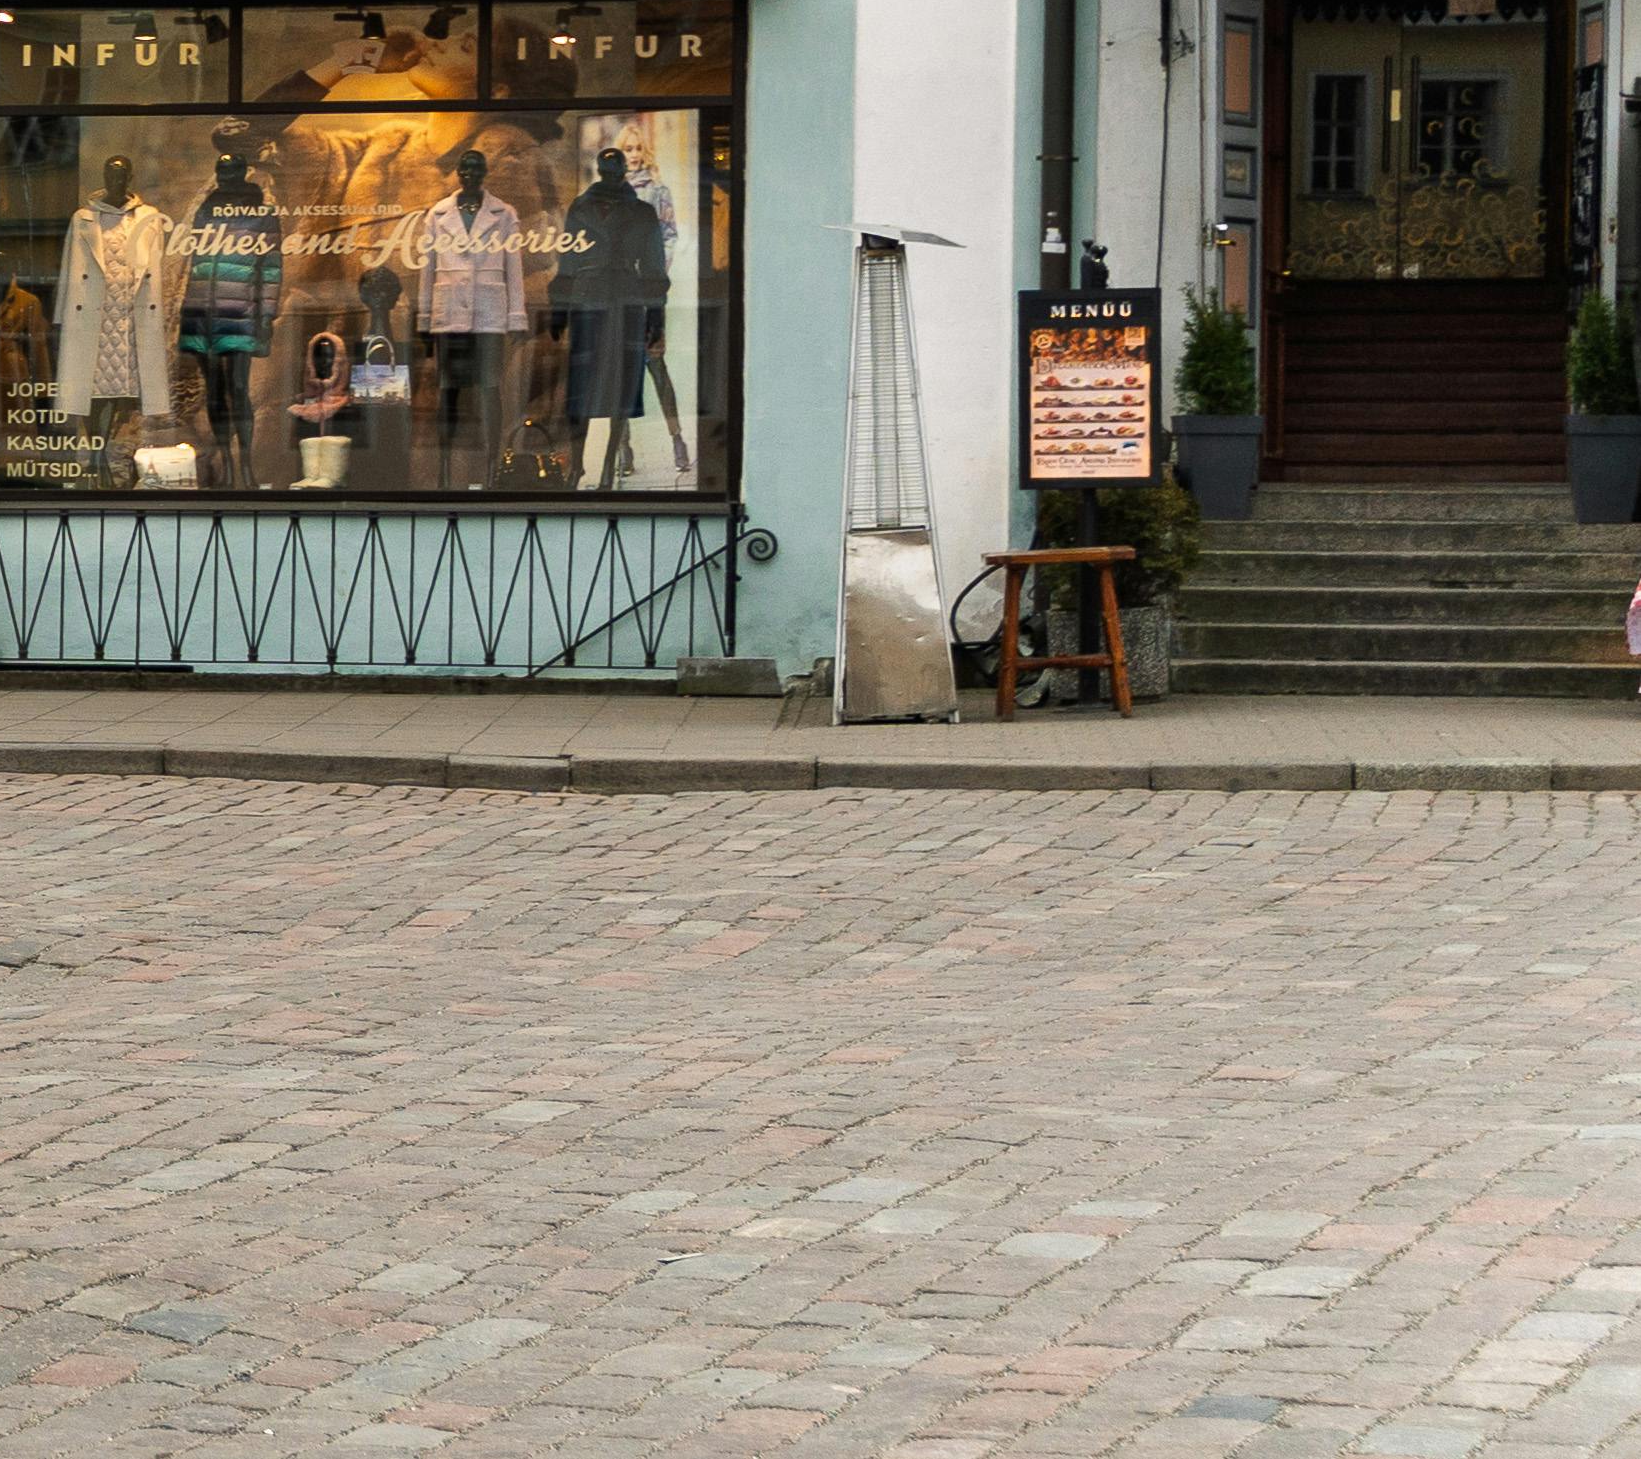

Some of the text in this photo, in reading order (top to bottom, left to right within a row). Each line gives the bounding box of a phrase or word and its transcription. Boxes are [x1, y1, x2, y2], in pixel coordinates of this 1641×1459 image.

[22, 43, 201, 67] INFUR
[517, 34, 703, 61] INFUR
[213, 203, 268, 217] RÕIVAD
[271, 205, 290, 217] JA
[124, 209, 596, 270] Clothes and Accessories
[1050, 301, 1132, 318] MENÜÜ
[7, 409, 68, 424] KOTID
[6, 435, 105, 451] KASUKAD
[6, 459, 98, 478] MÜTSID...
